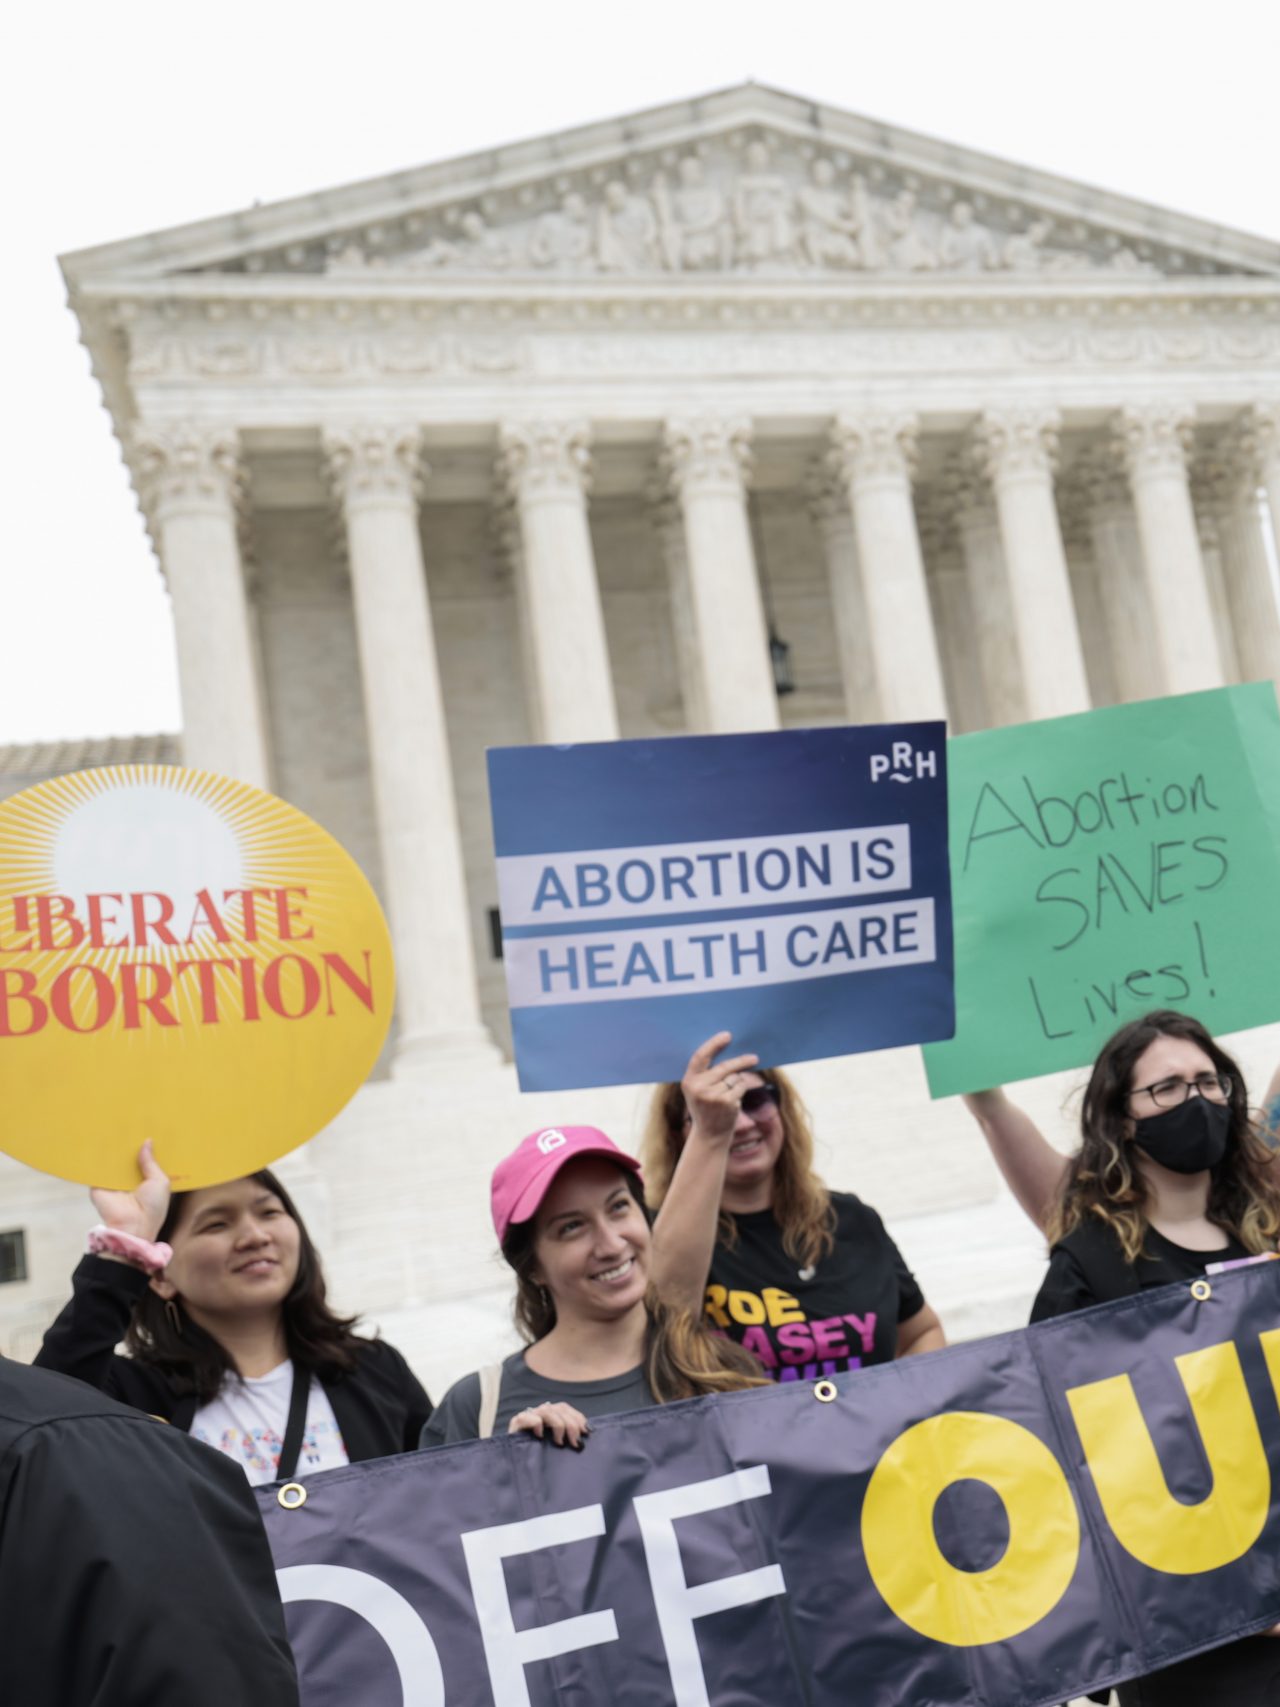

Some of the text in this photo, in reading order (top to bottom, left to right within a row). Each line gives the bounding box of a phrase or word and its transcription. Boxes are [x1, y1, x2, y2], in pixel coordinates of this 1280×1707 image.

[870, 742, 937, 783] PRH
[963, 772, 1221, 873] Abortion
[531, 837, 896, 912] ABORTION IS
[1036, 836, 1229, 951] SAVES
[538, 911, 919, 994] HEALTH CARE
[1029, 920, 1217, 1040] Lives!
[705, 1284, 806, 1328] ROE
[714, 1312, 877, 1368] ASEY
